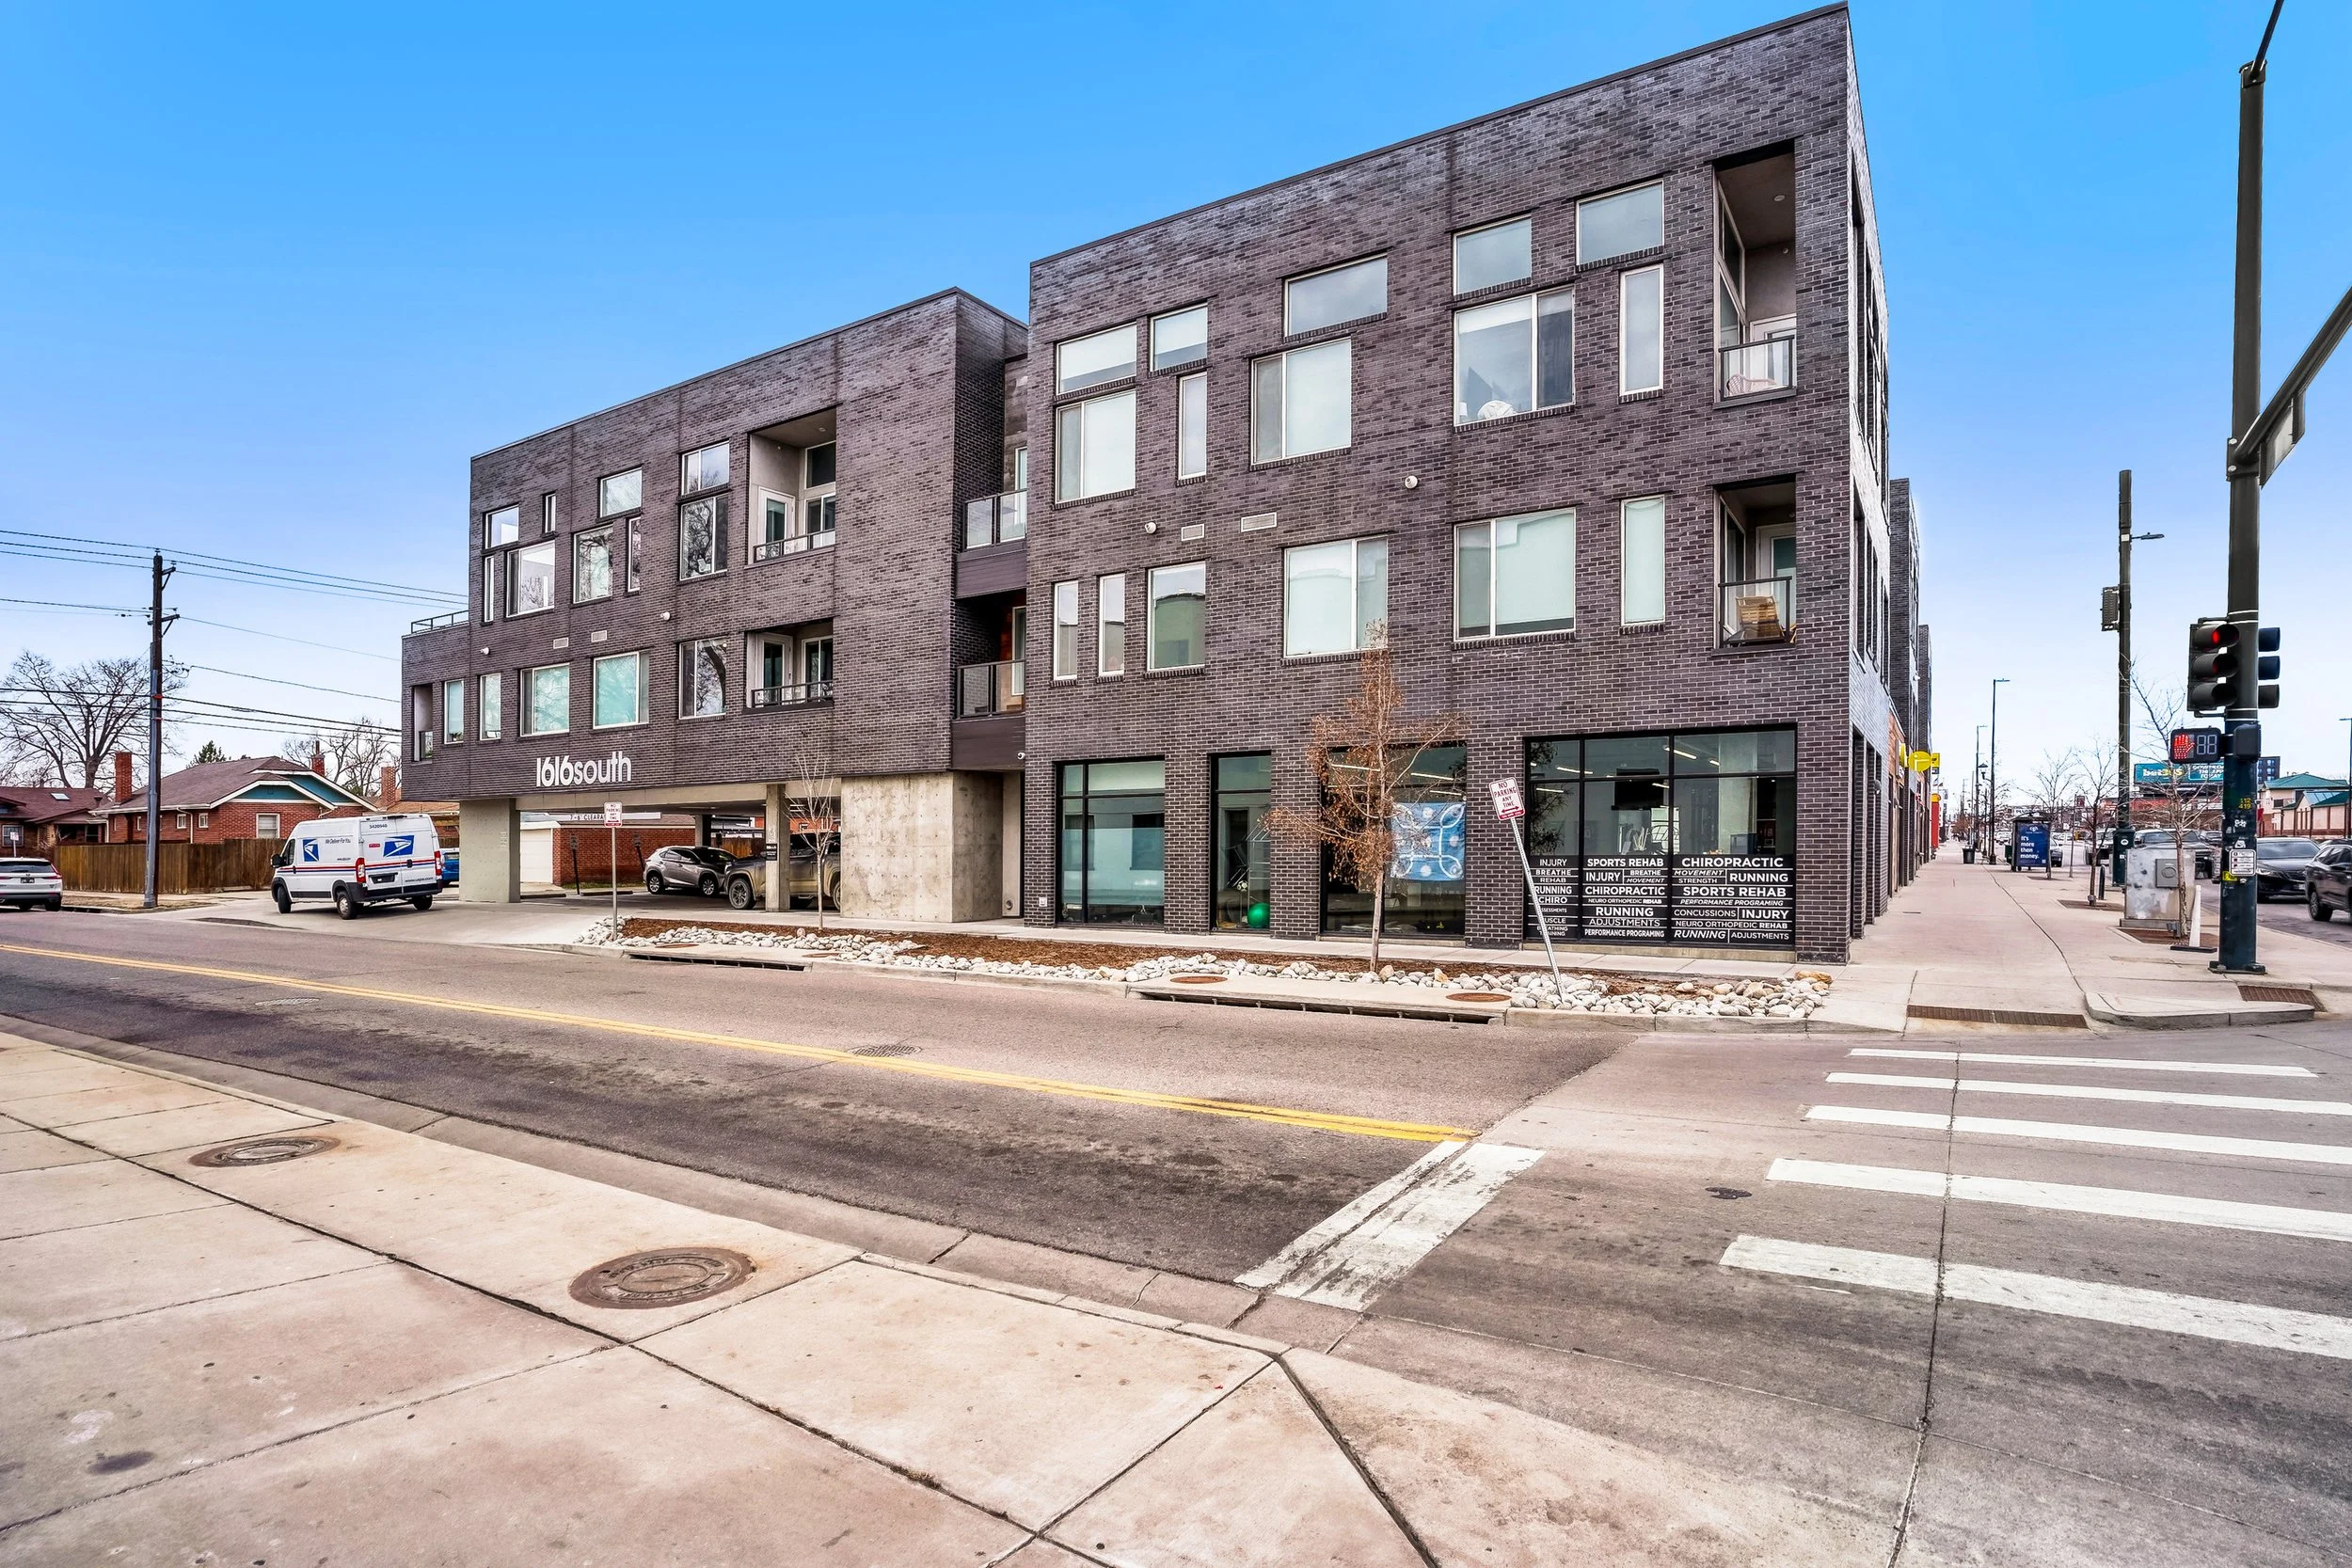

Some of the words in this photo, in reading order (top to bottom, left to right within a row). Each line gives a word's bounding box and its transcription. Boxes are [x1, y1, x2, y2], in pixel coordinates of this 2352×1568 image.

[536, 751, 631, 786] 1616south
[1494, 787, 1517, 798] PARKING
[1587, 858, 1626, 867] SPORTS
[1629, 858, 1664, 867] REHAB
[1682, 858, 1784, 867] CHIROPRACTIC
[1586, 872, 1621, 881] INJURY
[1730, 873, 1788, 882] RUNNING
[1534, 886, 1572, 895] RUNNING
[1585, 886, 1665, 895] CHIROPRACTIC
[1683, 887, 1735, 896] SPORTS
[1740, 887, 1787, 897] REHAB
[1596, 907, 1654, 917] RUNNING
[1742, 910, 1789, 919] INJURY
[1589, 918, 1661, 927] ADJUSTMENTS
[1627, 929, 1664, 938] PROGRAMING
[1675, 929, 1726, 939] RUNNING
